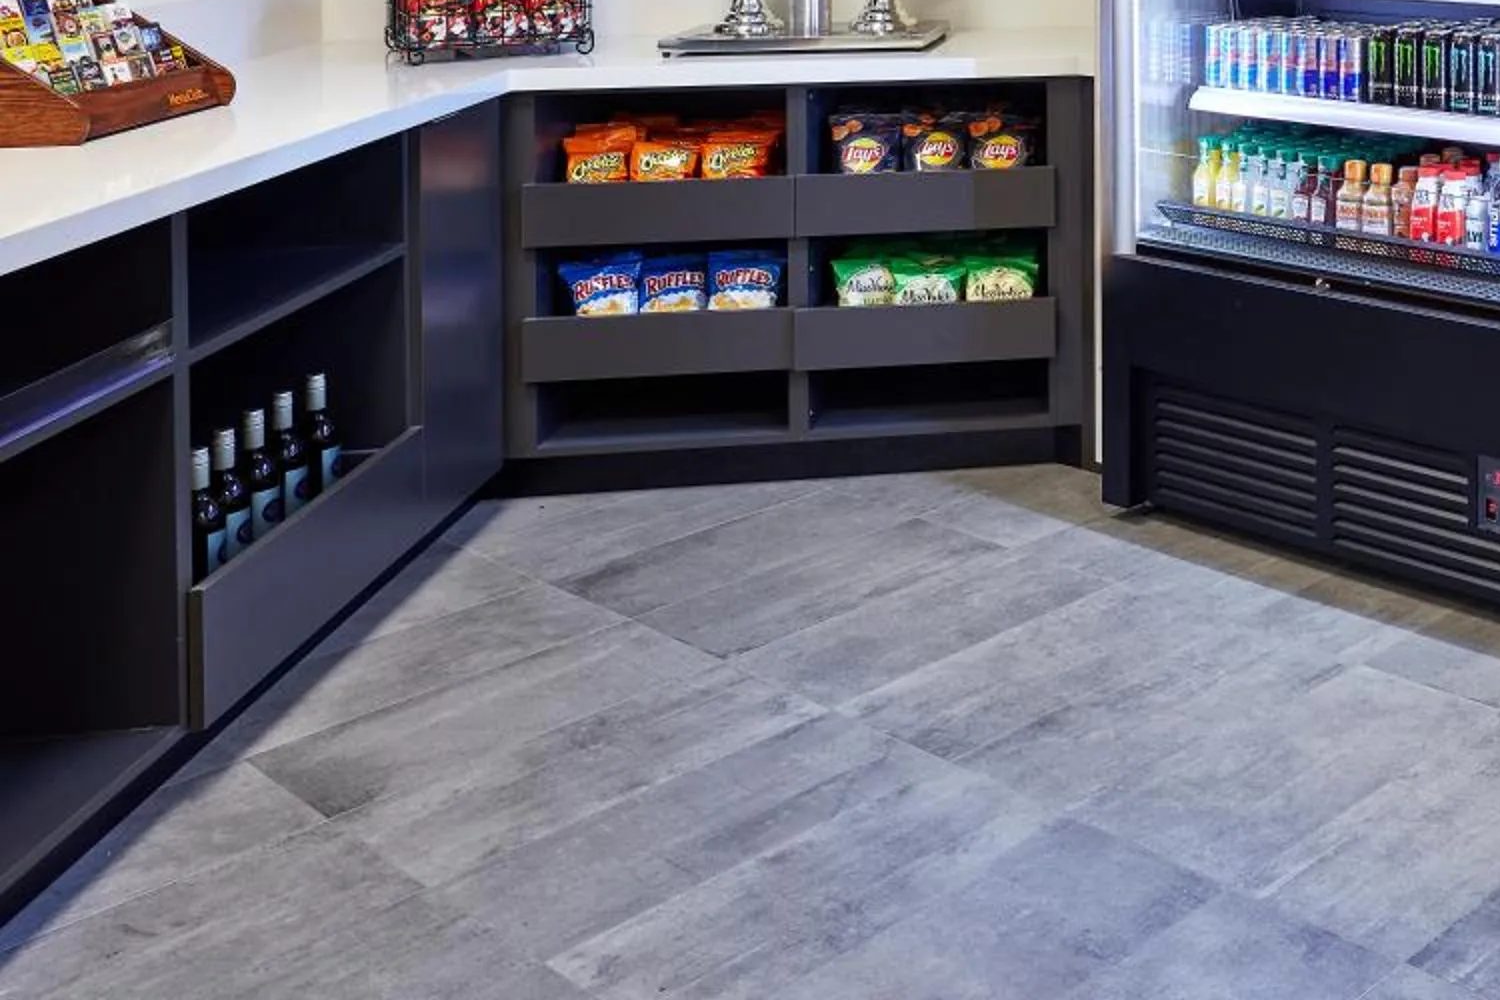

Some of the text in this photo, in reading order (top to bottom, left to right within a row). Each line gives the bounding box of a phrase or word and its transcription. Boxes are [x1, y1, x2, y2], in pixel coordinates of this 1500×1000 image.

[573, 272, 633, 302] RUFFLES
[646, 270, 705, 296] RUFFLES
[716, 267, 774, 288] RUFFLES
